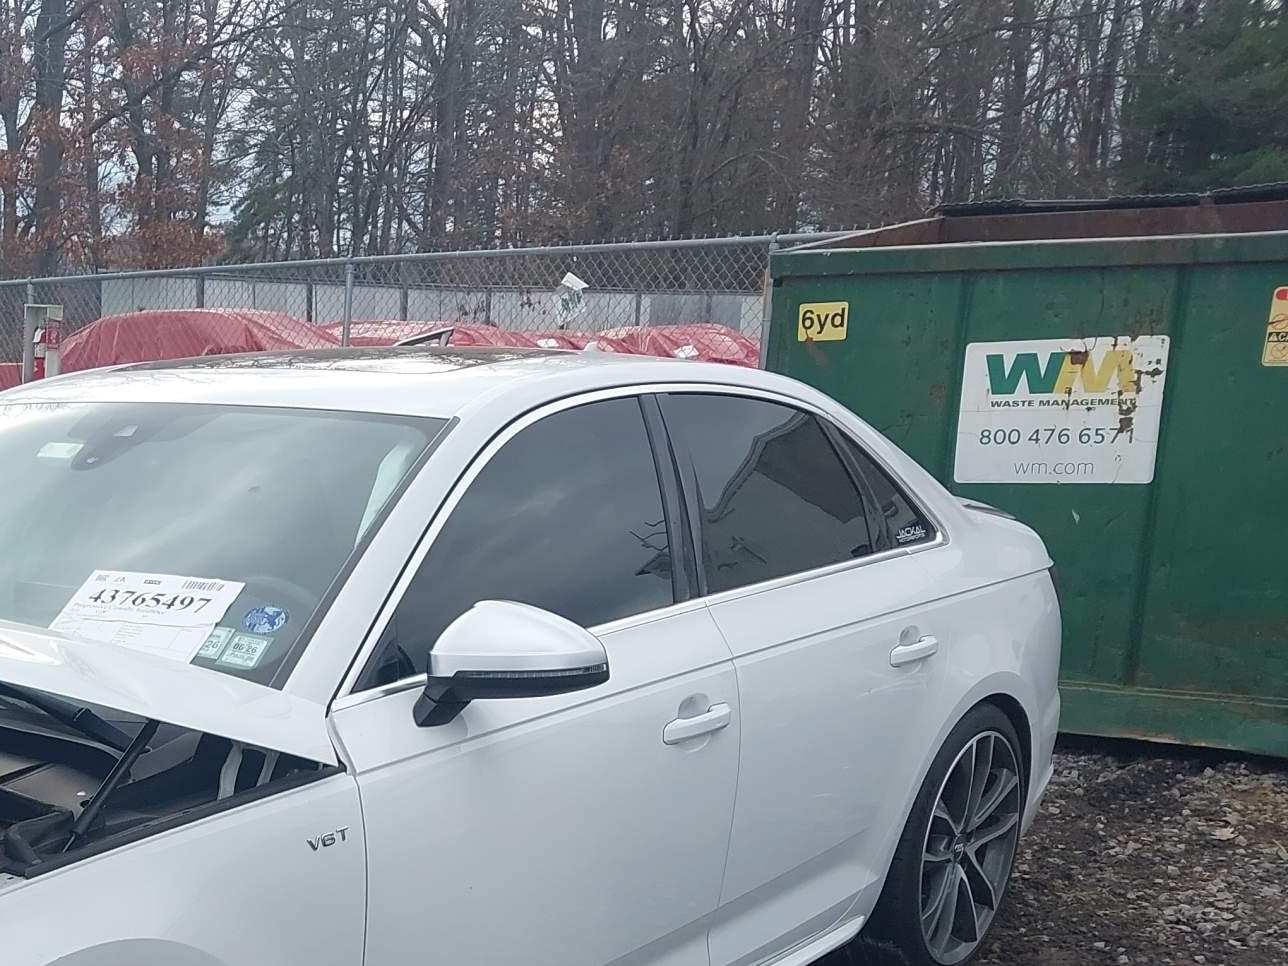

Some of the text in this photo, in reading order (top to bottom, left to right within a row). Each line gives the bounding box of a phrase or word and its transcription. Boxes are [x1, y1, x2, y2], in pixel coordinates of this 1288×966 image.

[801, 307, 846, 335] 6yd
[986, 350, 1137, 395] WM
[990, 398, 1137, 408] WASTE MANAGEMENT
[979, 427, 1134, 445] 800 476 6571
[1013, 459, 1095, 475] wm.com
[88, 588, 214, 614] 43765497
[306, 825, 350, 852] V6T
